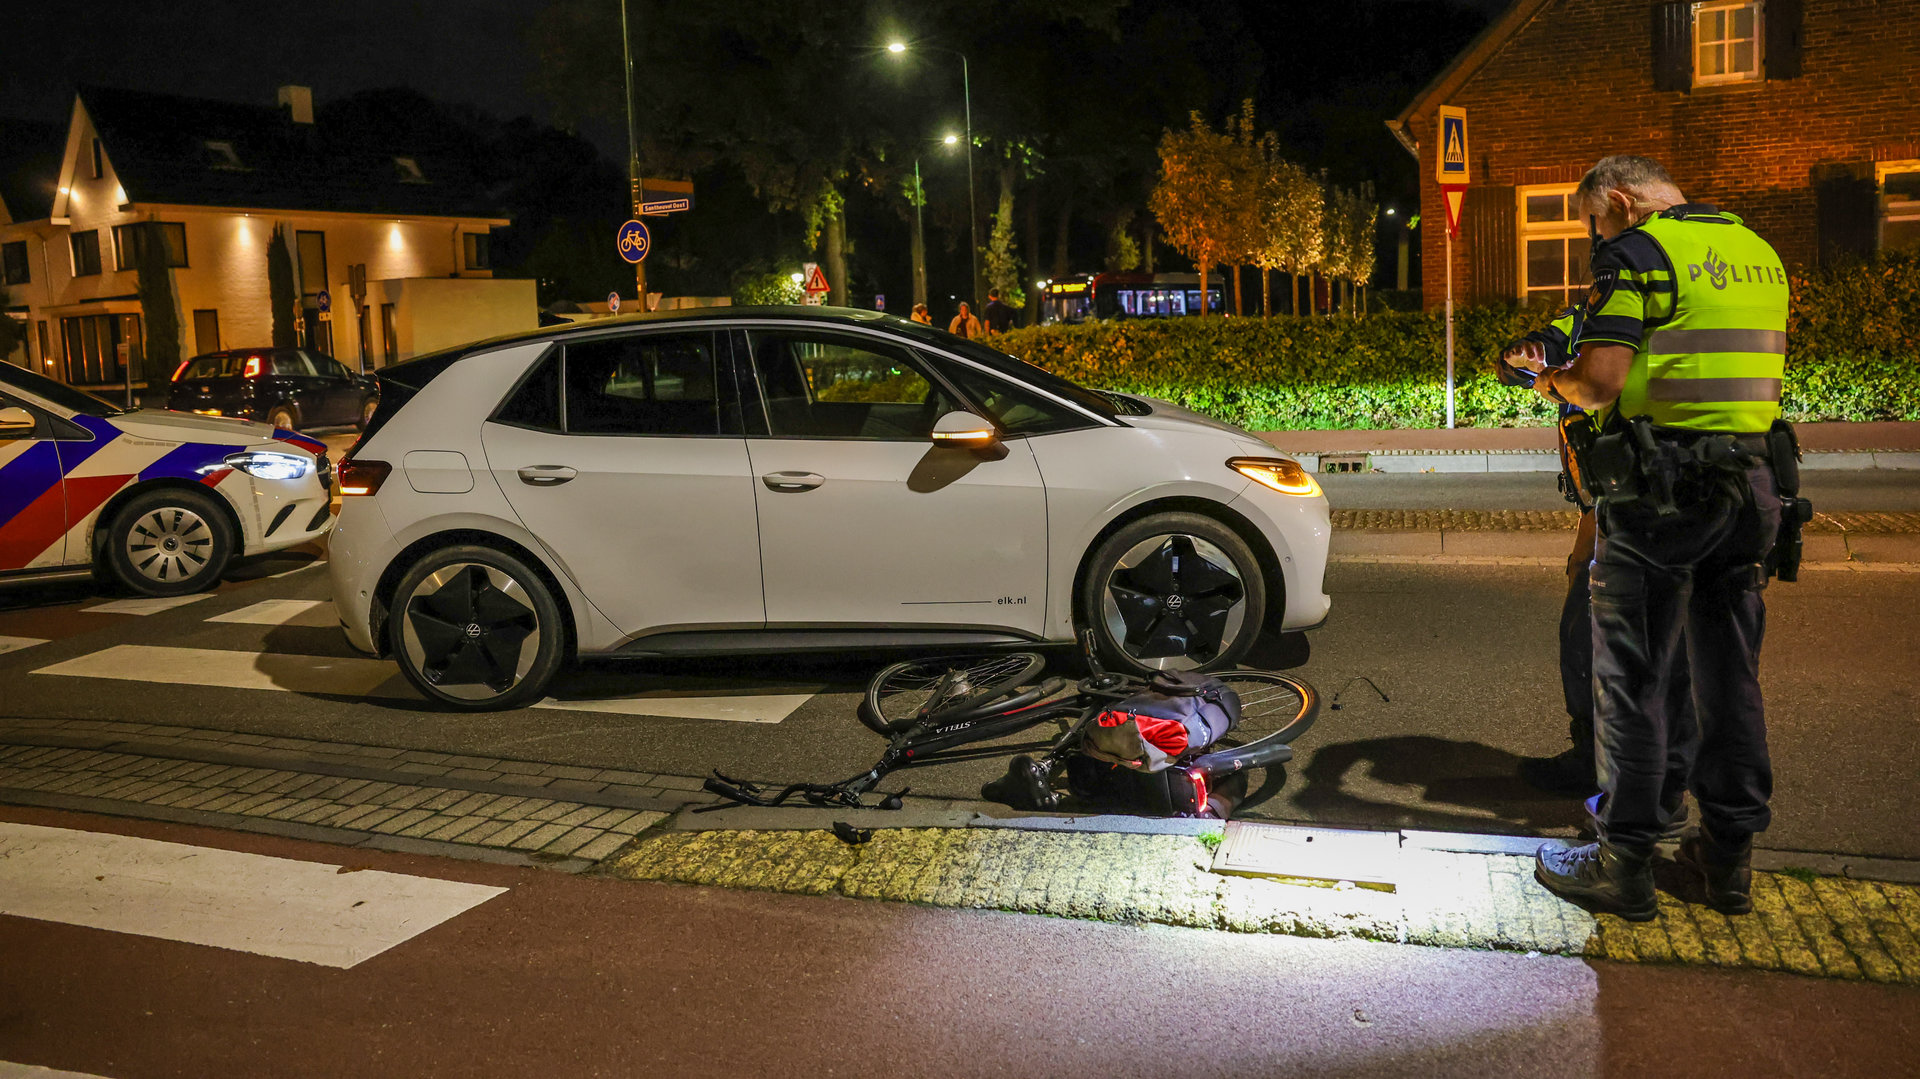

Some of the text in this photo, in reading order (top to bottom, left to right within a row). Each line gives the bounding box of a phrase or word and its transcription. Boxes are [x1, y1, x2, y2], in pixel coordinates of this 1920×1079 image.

[1687, 262, 1785, 290] POLITIE
[997, 596, 1027, 605] elk.nl
[936, 721, 971, 734] STELLA
